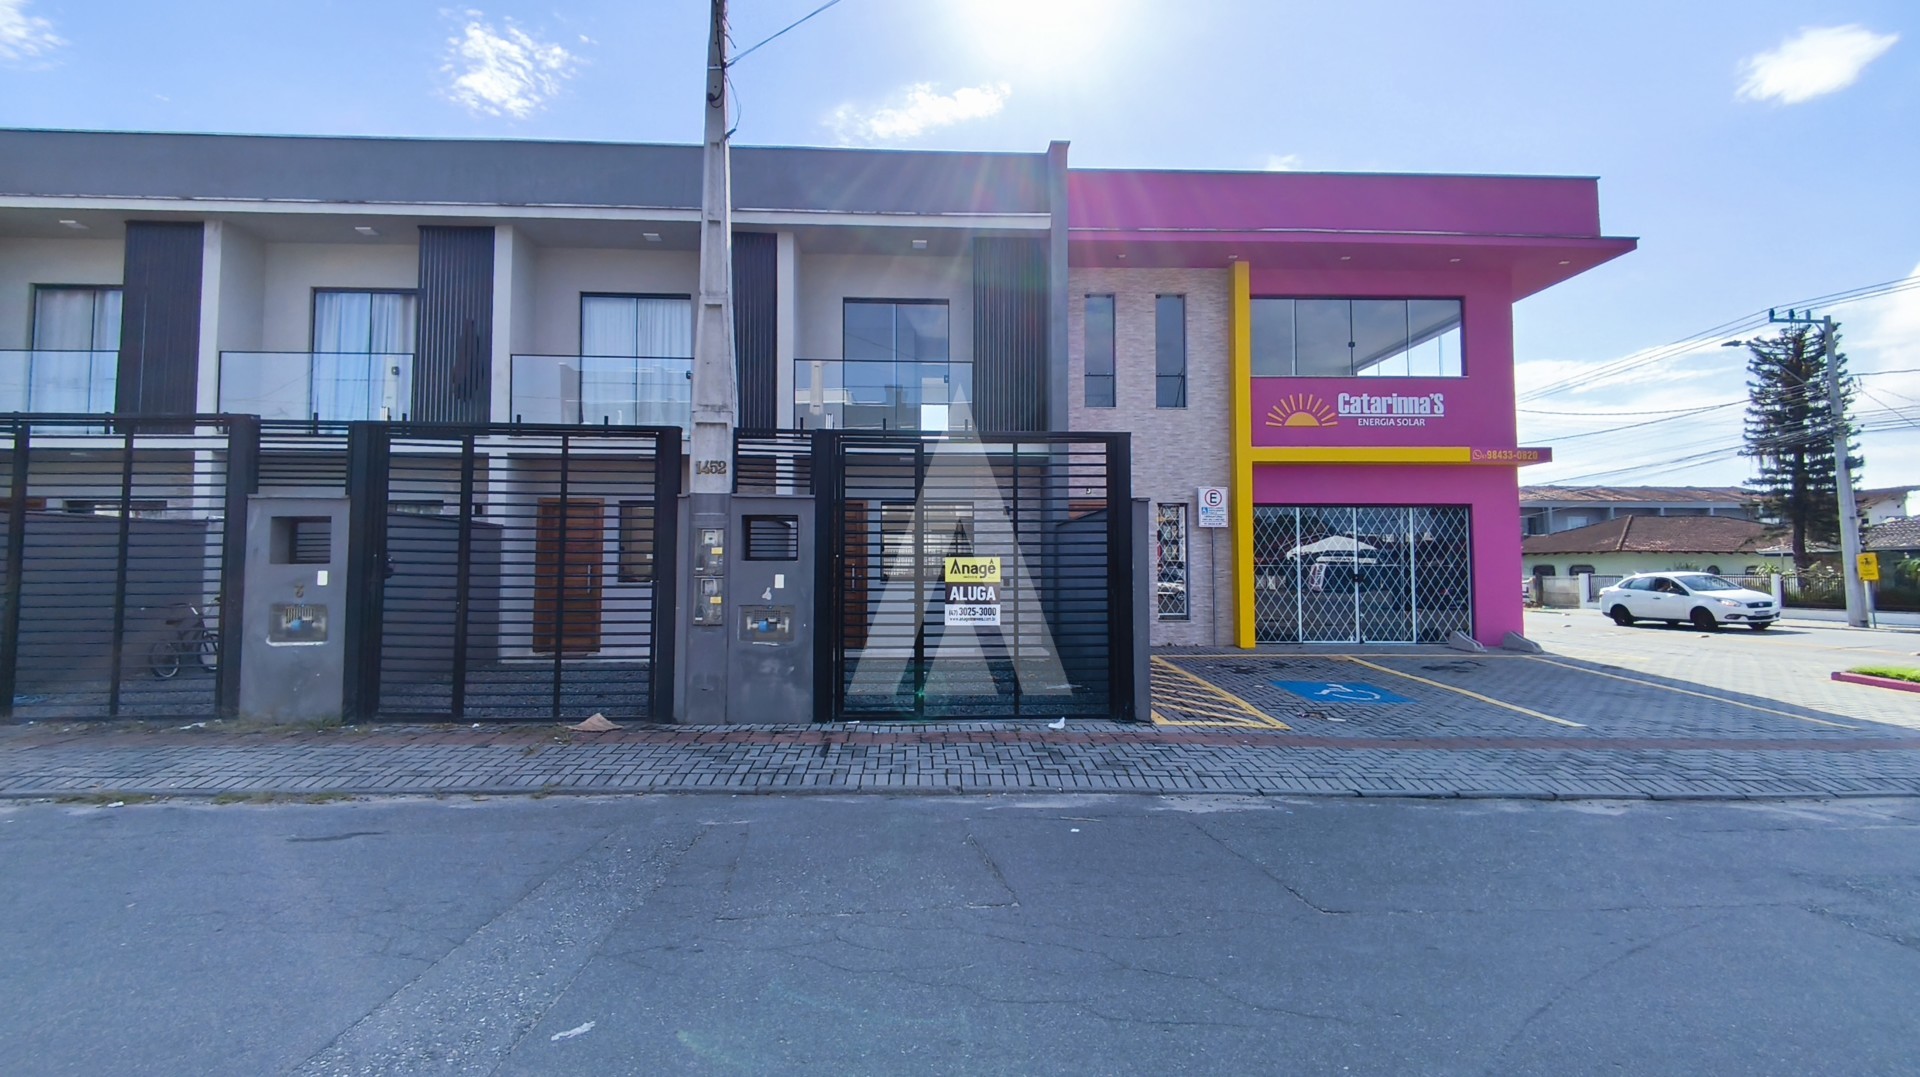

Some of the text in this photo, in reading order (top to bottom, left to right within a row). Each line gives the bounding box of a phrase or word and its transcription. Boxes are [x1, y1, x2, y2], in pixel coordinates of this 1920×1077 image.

[1357, 418, 1426, 427] ENERGIA SOLAR
[695, 460, 727, 475] 1452
[1209, 492, 1218, 504] E
[950, 558, 996, 578] Anagê
[949, 586, 996, 601] ALUGA
[959, 607, 996, 616] 3025-3000
